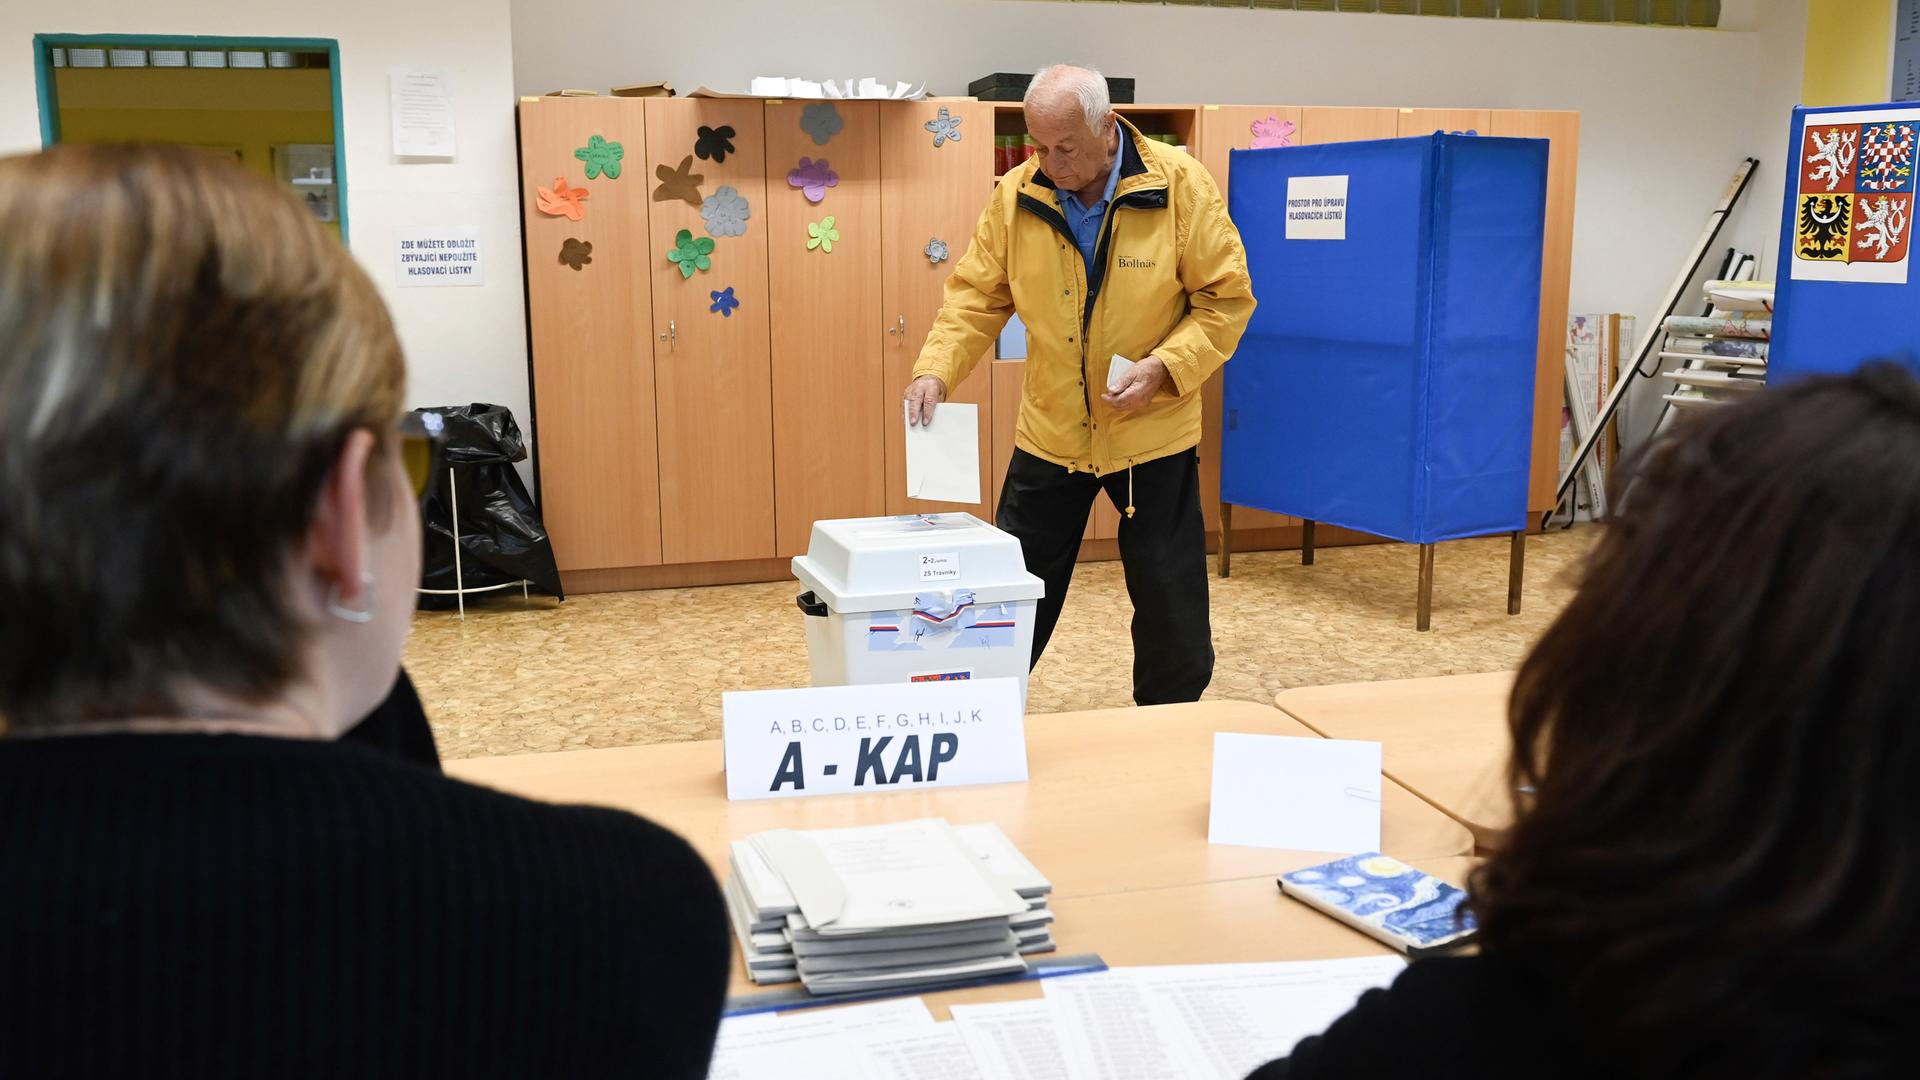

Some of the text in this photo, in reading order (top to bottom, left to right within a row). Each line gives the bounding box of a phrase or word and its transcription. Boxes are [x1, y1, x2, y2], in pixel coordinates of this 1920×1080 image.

[1288, 199, 1311, 207] PROSTOR
[1311, 198, 1323, 207] PRO
[401, 238, 475, 249] ZDE MŮŽETE ODLOŽIT
[1118, 258, 1156, 268] Bollnäs
[408, 265, 472, 275] HLASOVACÍ LÍSTKY
[970, 709, 984, 722] K
[769, 732, 959, 791] A - KAP
